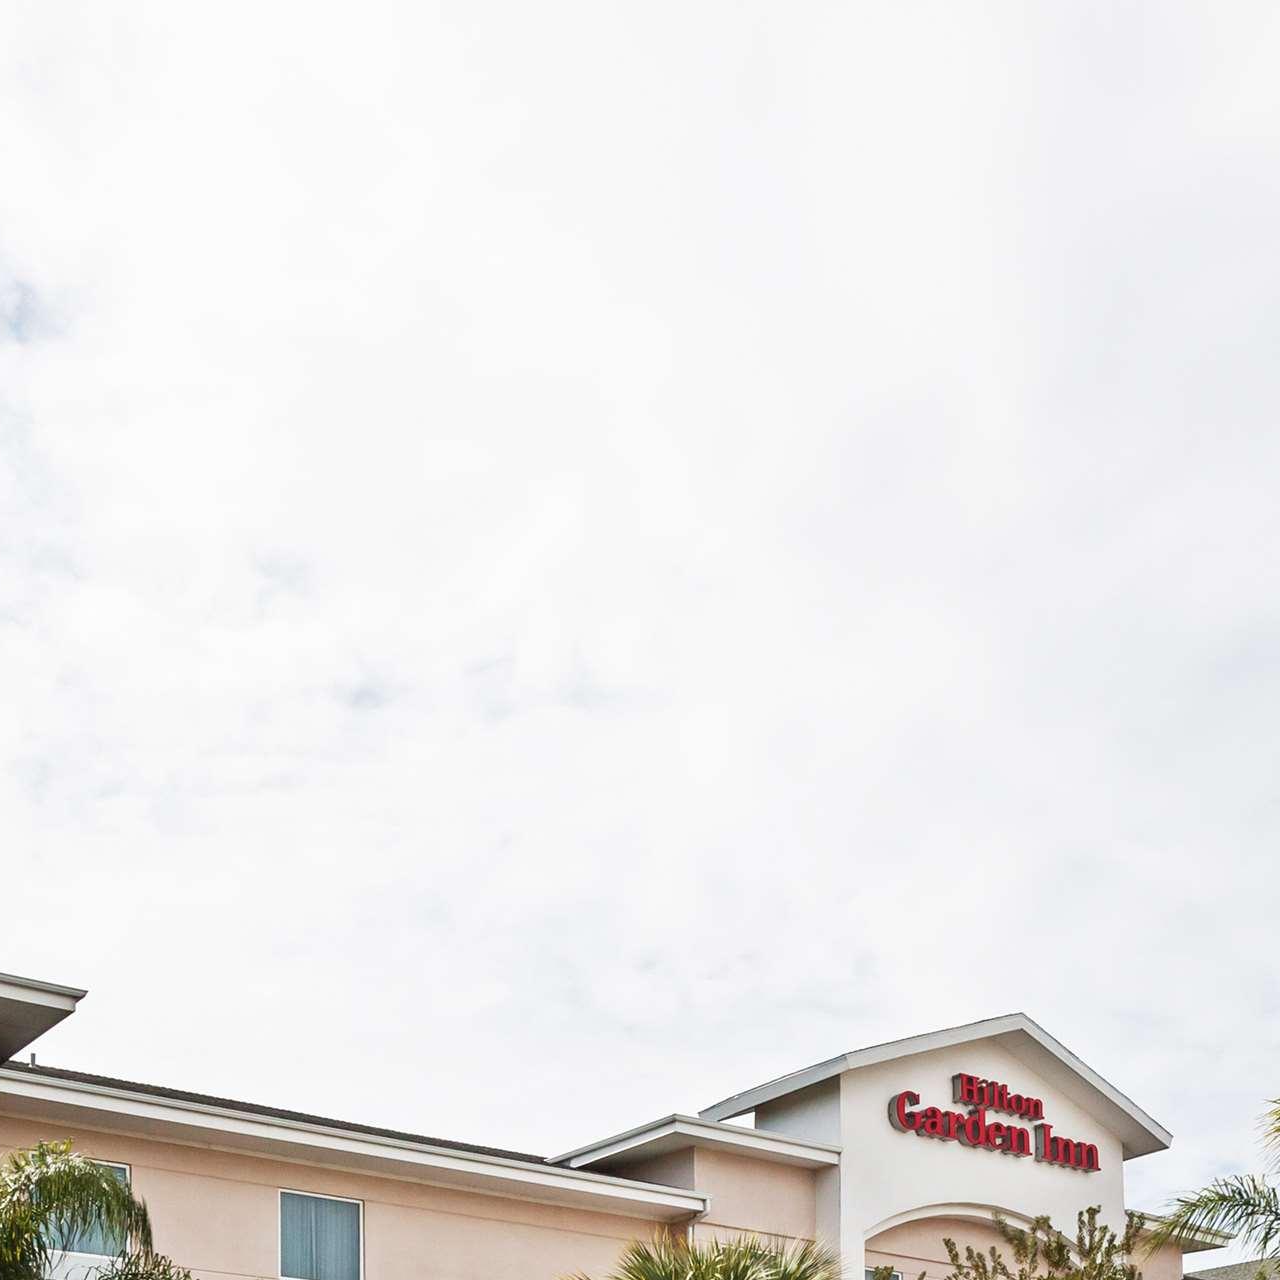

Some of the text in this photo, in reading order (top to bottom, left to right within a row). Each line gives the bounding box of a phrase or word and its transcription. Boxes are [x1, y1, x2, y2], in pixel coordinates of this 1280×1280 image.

[953, 1073, 1044, 1121] Hilton
[889, 1091, 1101, 1172] Garden Inn
